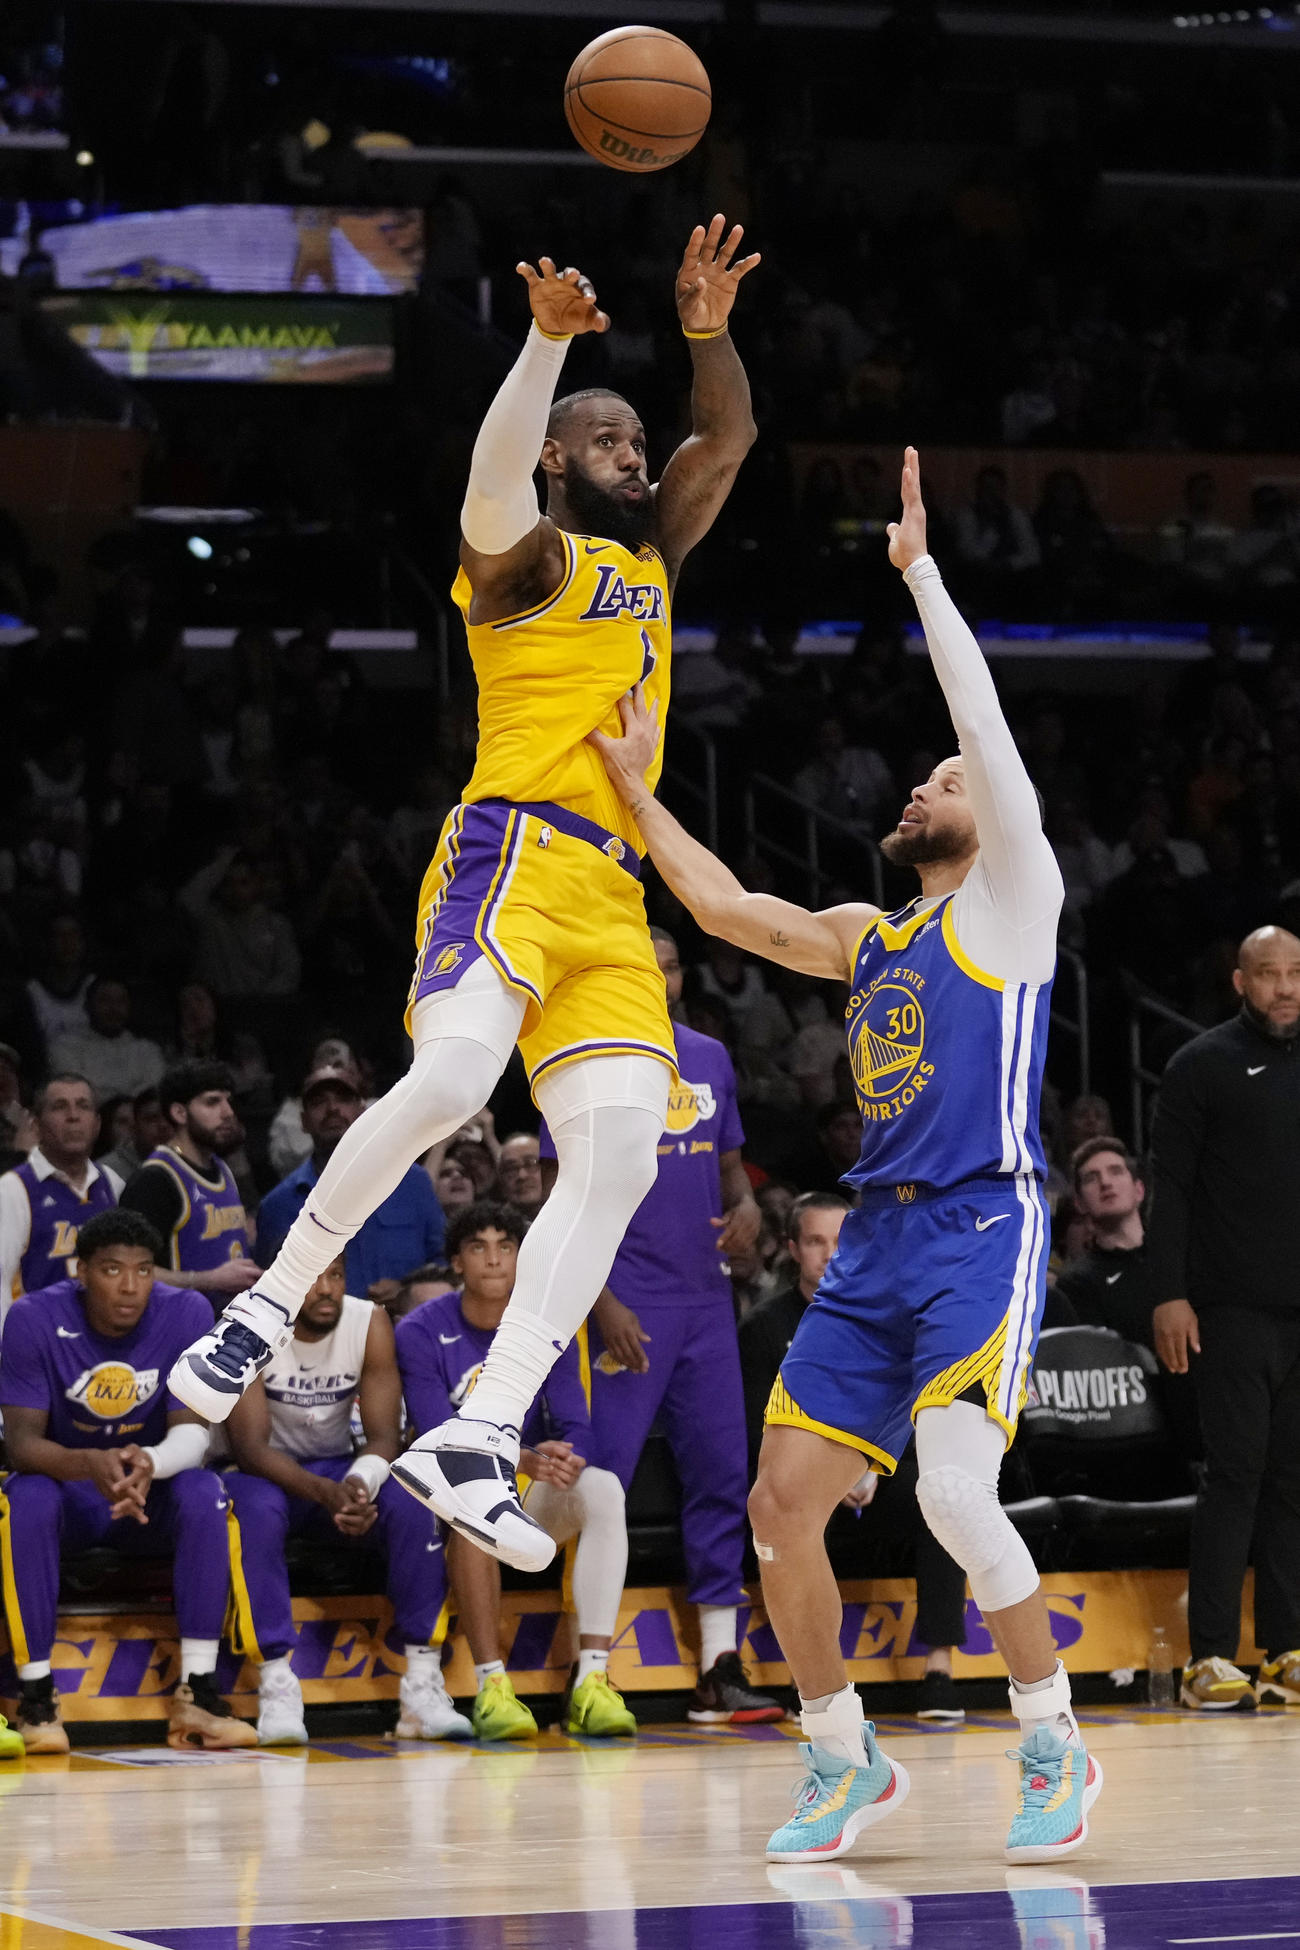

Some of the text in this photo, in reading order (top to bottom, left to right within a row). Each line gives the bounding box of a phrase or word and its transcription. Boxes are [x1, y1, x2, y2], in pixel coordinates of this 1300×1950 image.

[892, 967, 926, 991] STATE
[886, 1003, 917, 1040] 30
[283, 1392, 337, 1406] BASKETBALL
[1036, 1365, 1147, 1410] PLAYOFFS
